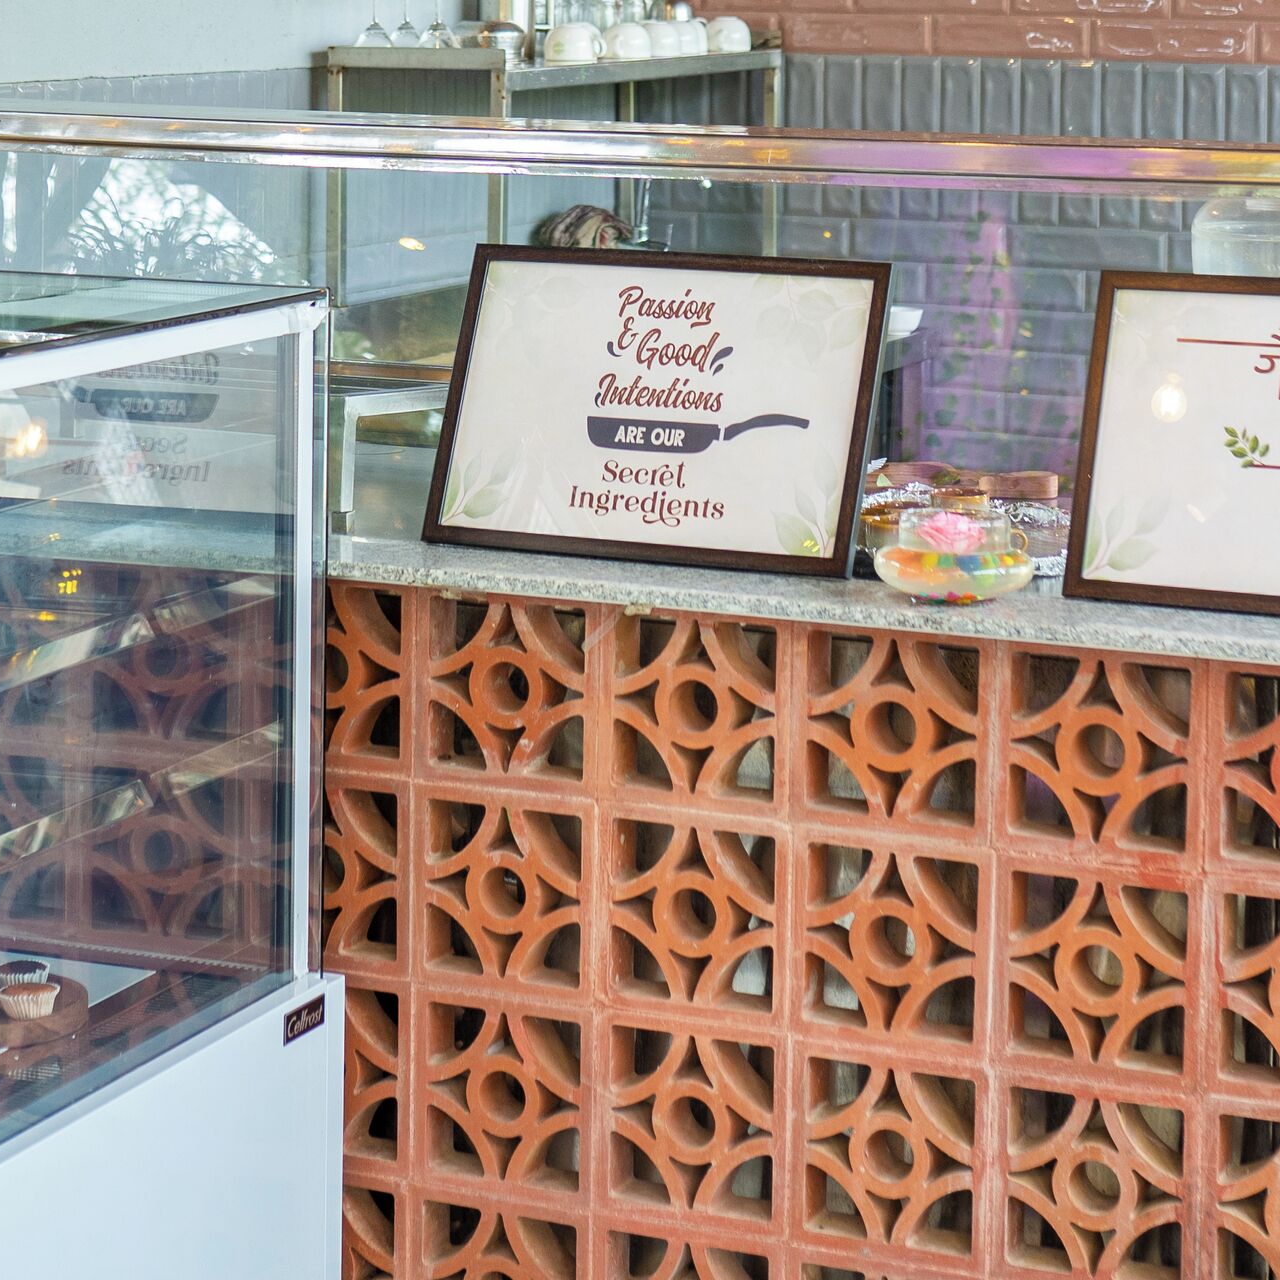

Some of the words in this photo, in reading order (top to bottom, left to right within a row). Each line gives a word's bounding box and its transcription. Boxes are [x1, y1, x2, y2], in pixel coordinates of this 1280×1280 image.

[618, 285, 716, 329] Passion
[617, 316, 639, 350] &
[636, 328, 720, 373] Good
[599, 373, 723, 412] Intentions
[614, 425, 645, 446] ARE
[650, 426, 684, 447] OUR
[602, 460, 686, 489] Secret
[568, 485, 725, 527] Ingredients
